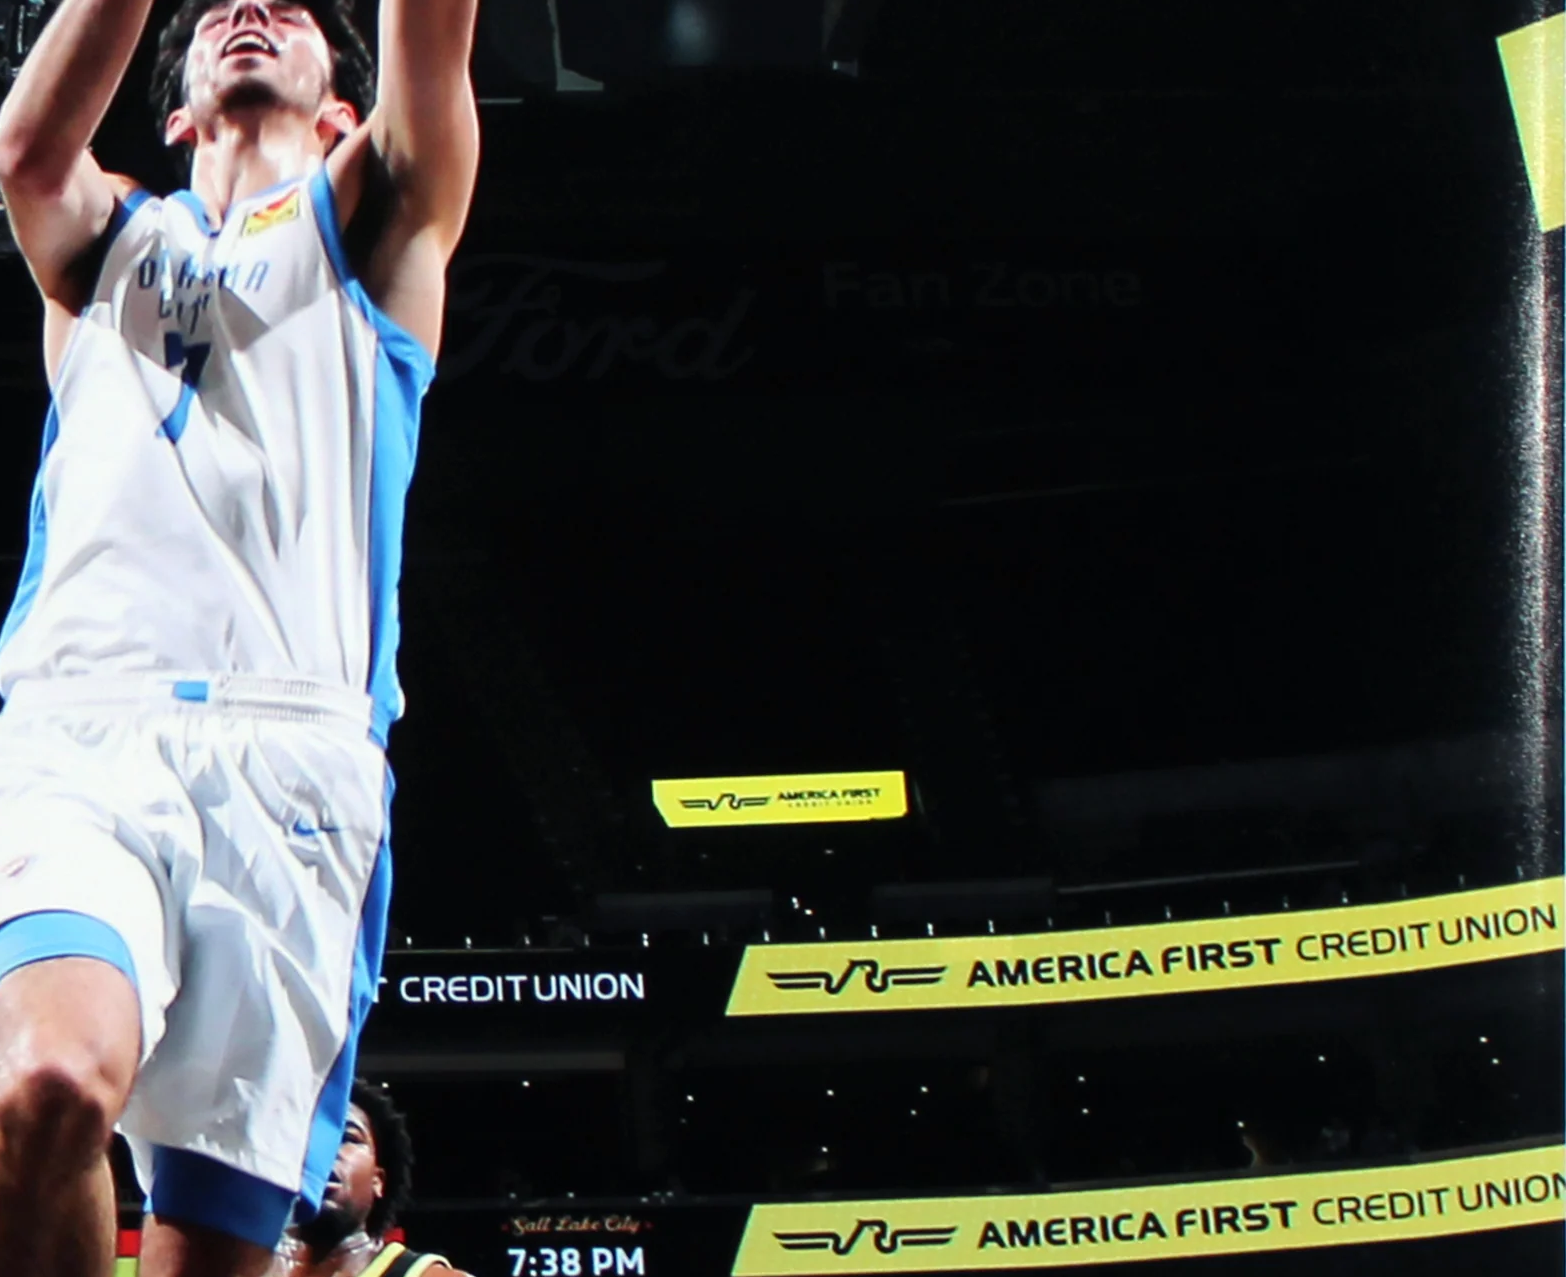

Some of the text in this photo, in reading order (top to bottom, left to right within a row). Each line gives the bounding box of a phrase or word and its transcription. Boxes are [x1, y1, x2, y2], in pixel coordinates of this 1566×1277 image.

[966, 904, 1557, 988] AMERICA FIRST CREDIT UNION
[400, 975, 527, 1003] CREDIT
[534, 973, 645, 1002] UNION
[977, 1211, 1169, 1249] AMERICA
[1176, 1200, 1298, 1238] FIRST
[1313, 1188, 1450, 1226] CREDIT
[507, 1247, 645, 1277] 7:38 PM
